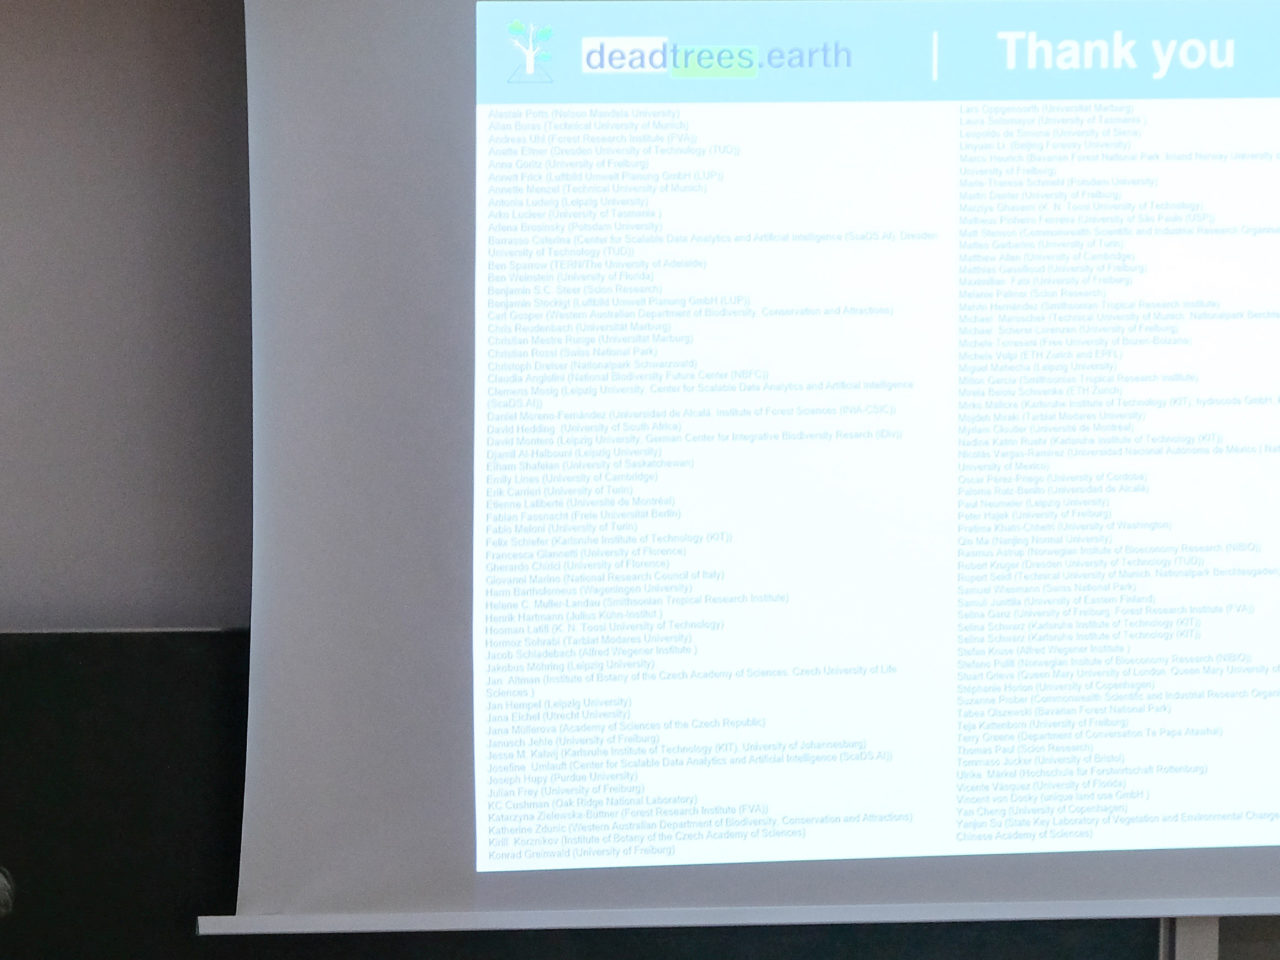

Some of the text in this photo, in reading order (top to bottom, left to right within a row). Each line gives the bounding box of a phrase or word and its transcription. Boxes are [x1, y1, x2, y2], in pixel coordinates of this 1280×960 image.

[586, 41, 852, 70] deadtrees.earth
[997, 30, 1235, 80] Thank you
